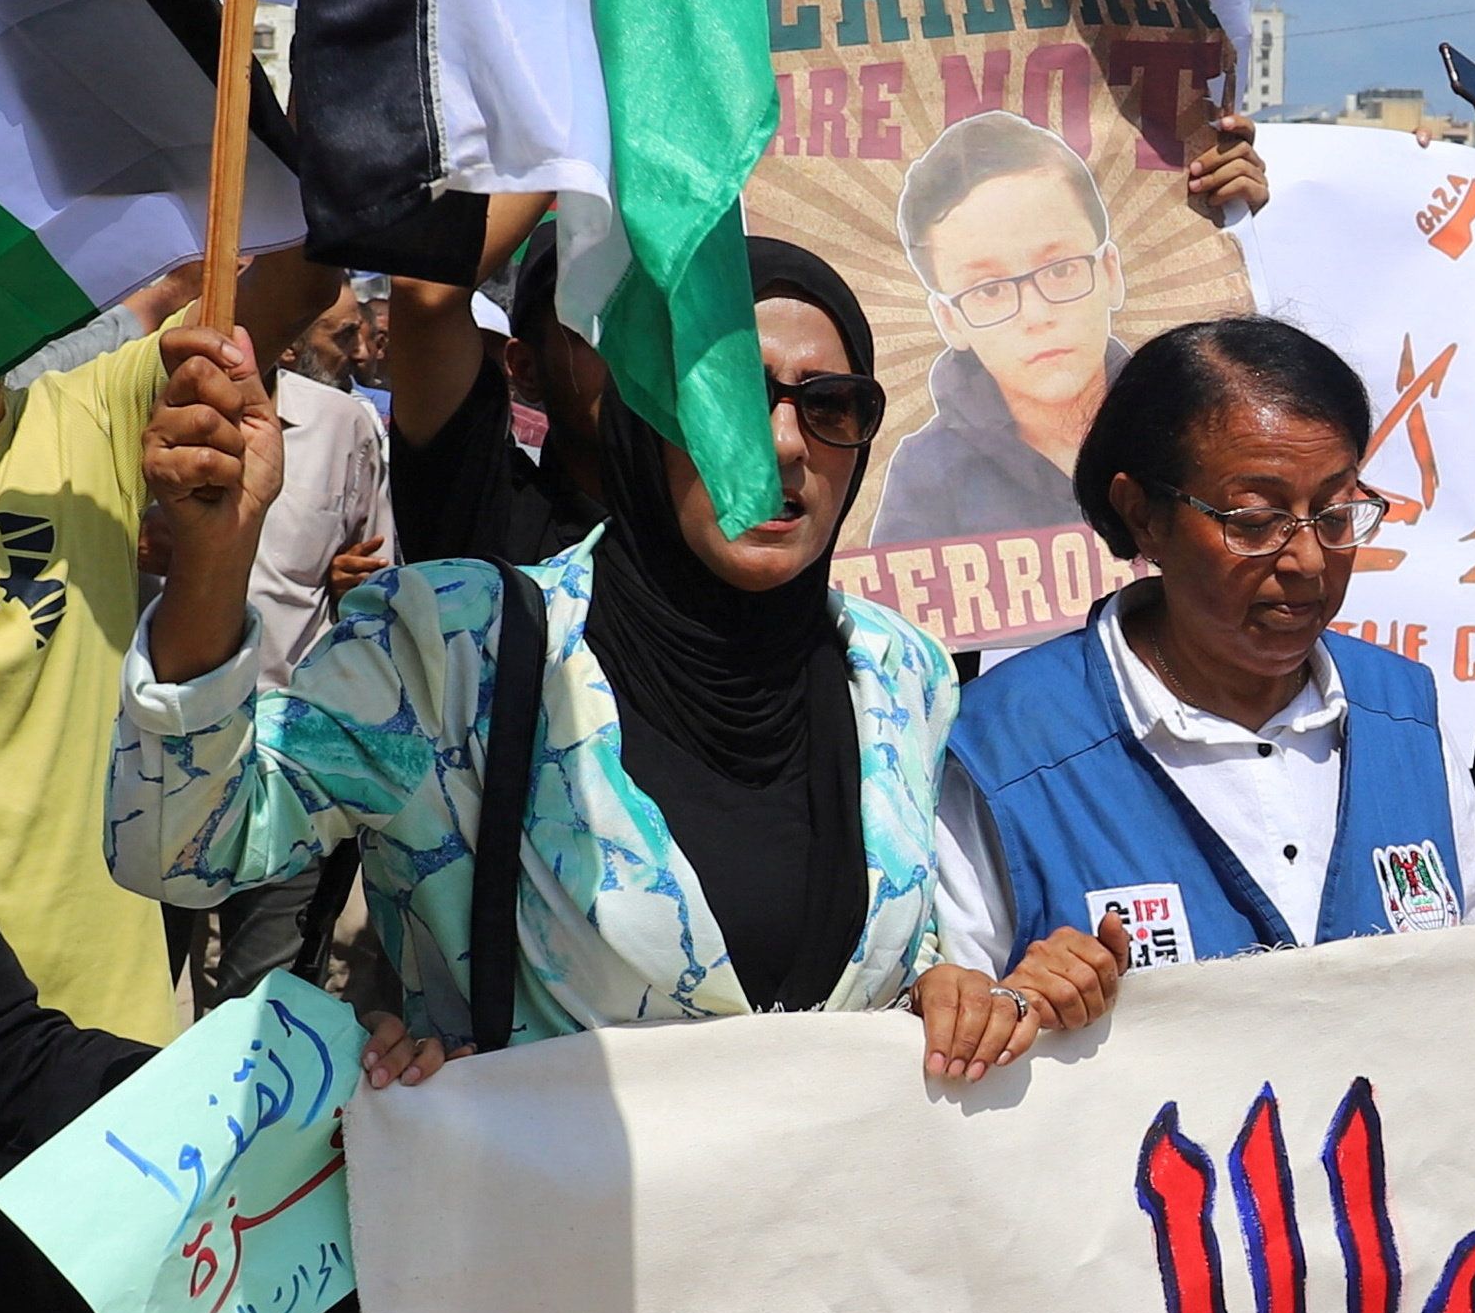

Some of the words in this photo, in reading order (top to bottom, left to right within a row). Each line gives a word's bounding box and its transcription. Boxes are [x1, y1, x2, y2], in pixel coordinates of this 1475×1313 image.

[940, 40, 1222, 172] NOT
[1416, 174, 1469, 234] GAZA
[1132, 895, 1170, 923] IFJ
